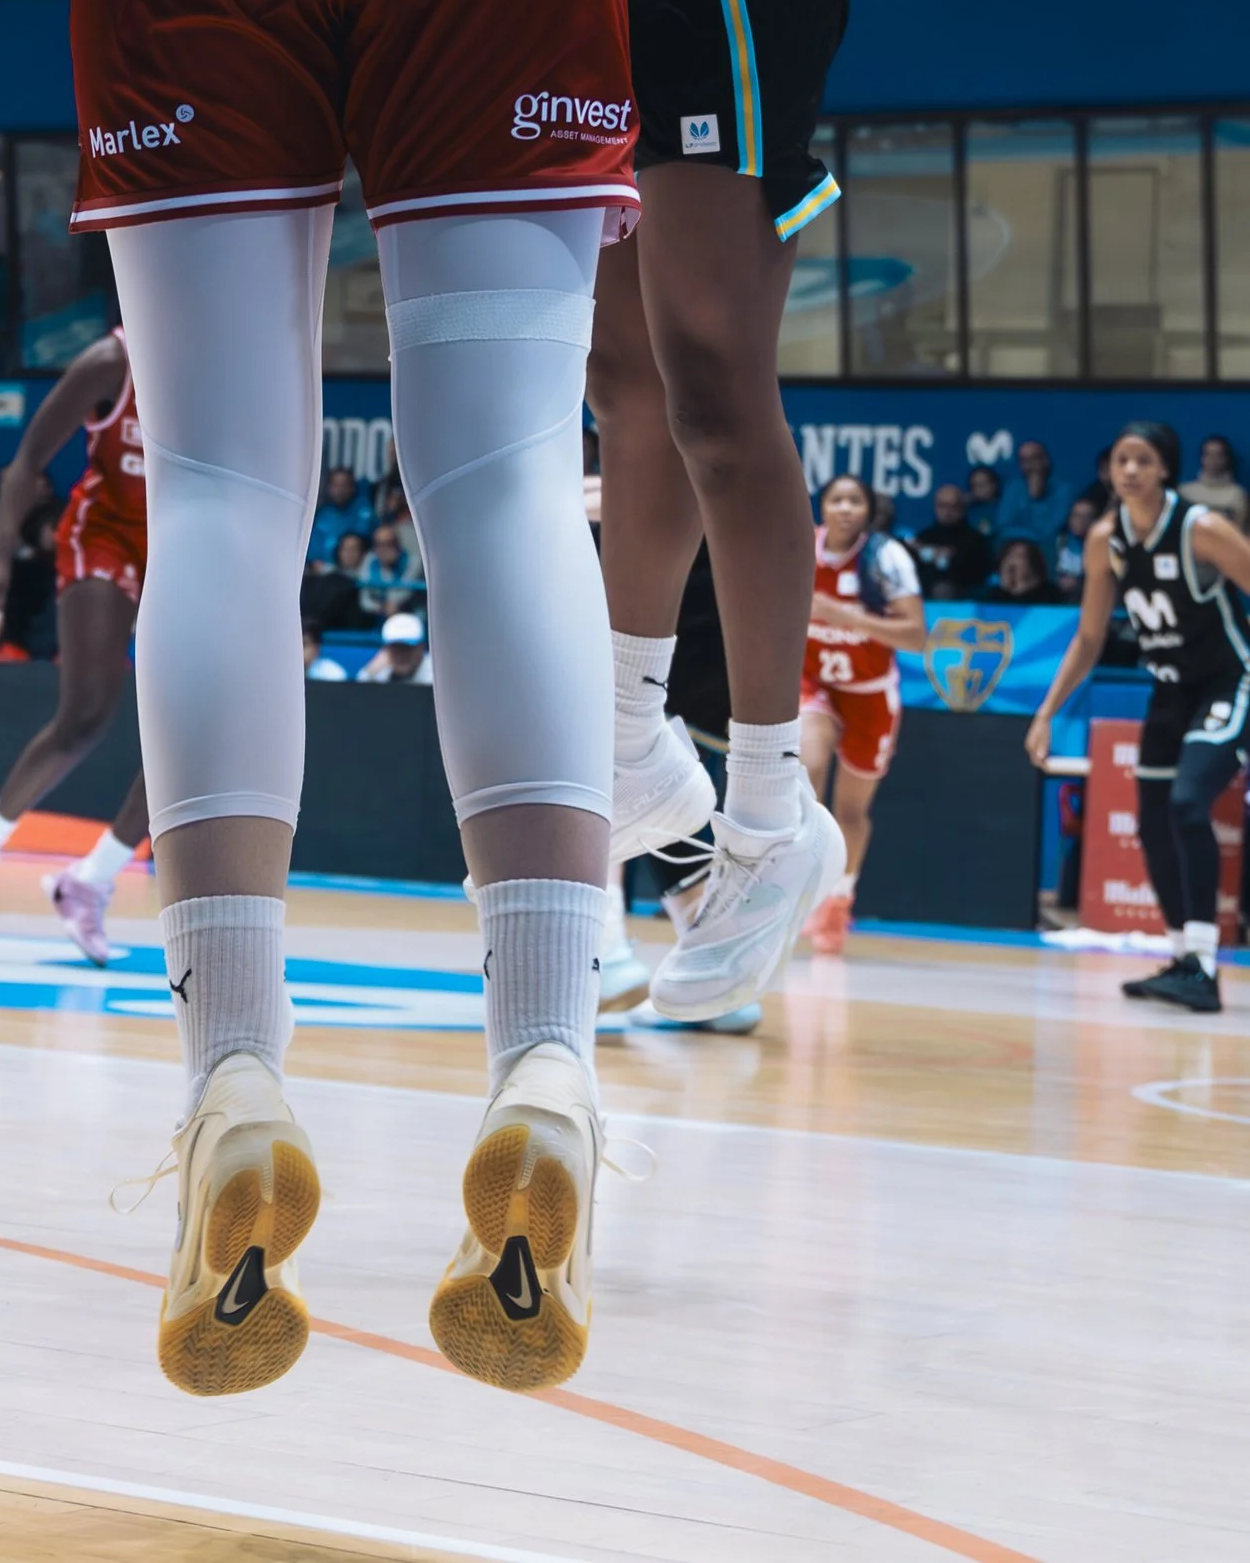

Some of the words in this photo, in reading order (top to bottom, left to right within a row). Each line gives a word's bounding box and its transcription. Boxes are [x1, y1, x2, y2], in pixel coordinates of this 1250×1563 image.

[510, 90, 632, 140] ginvest
[89, 120, 182, 159] Marlex
[550, 130, 579, 140] ASSET
[818, 648, 855, 683] 23
